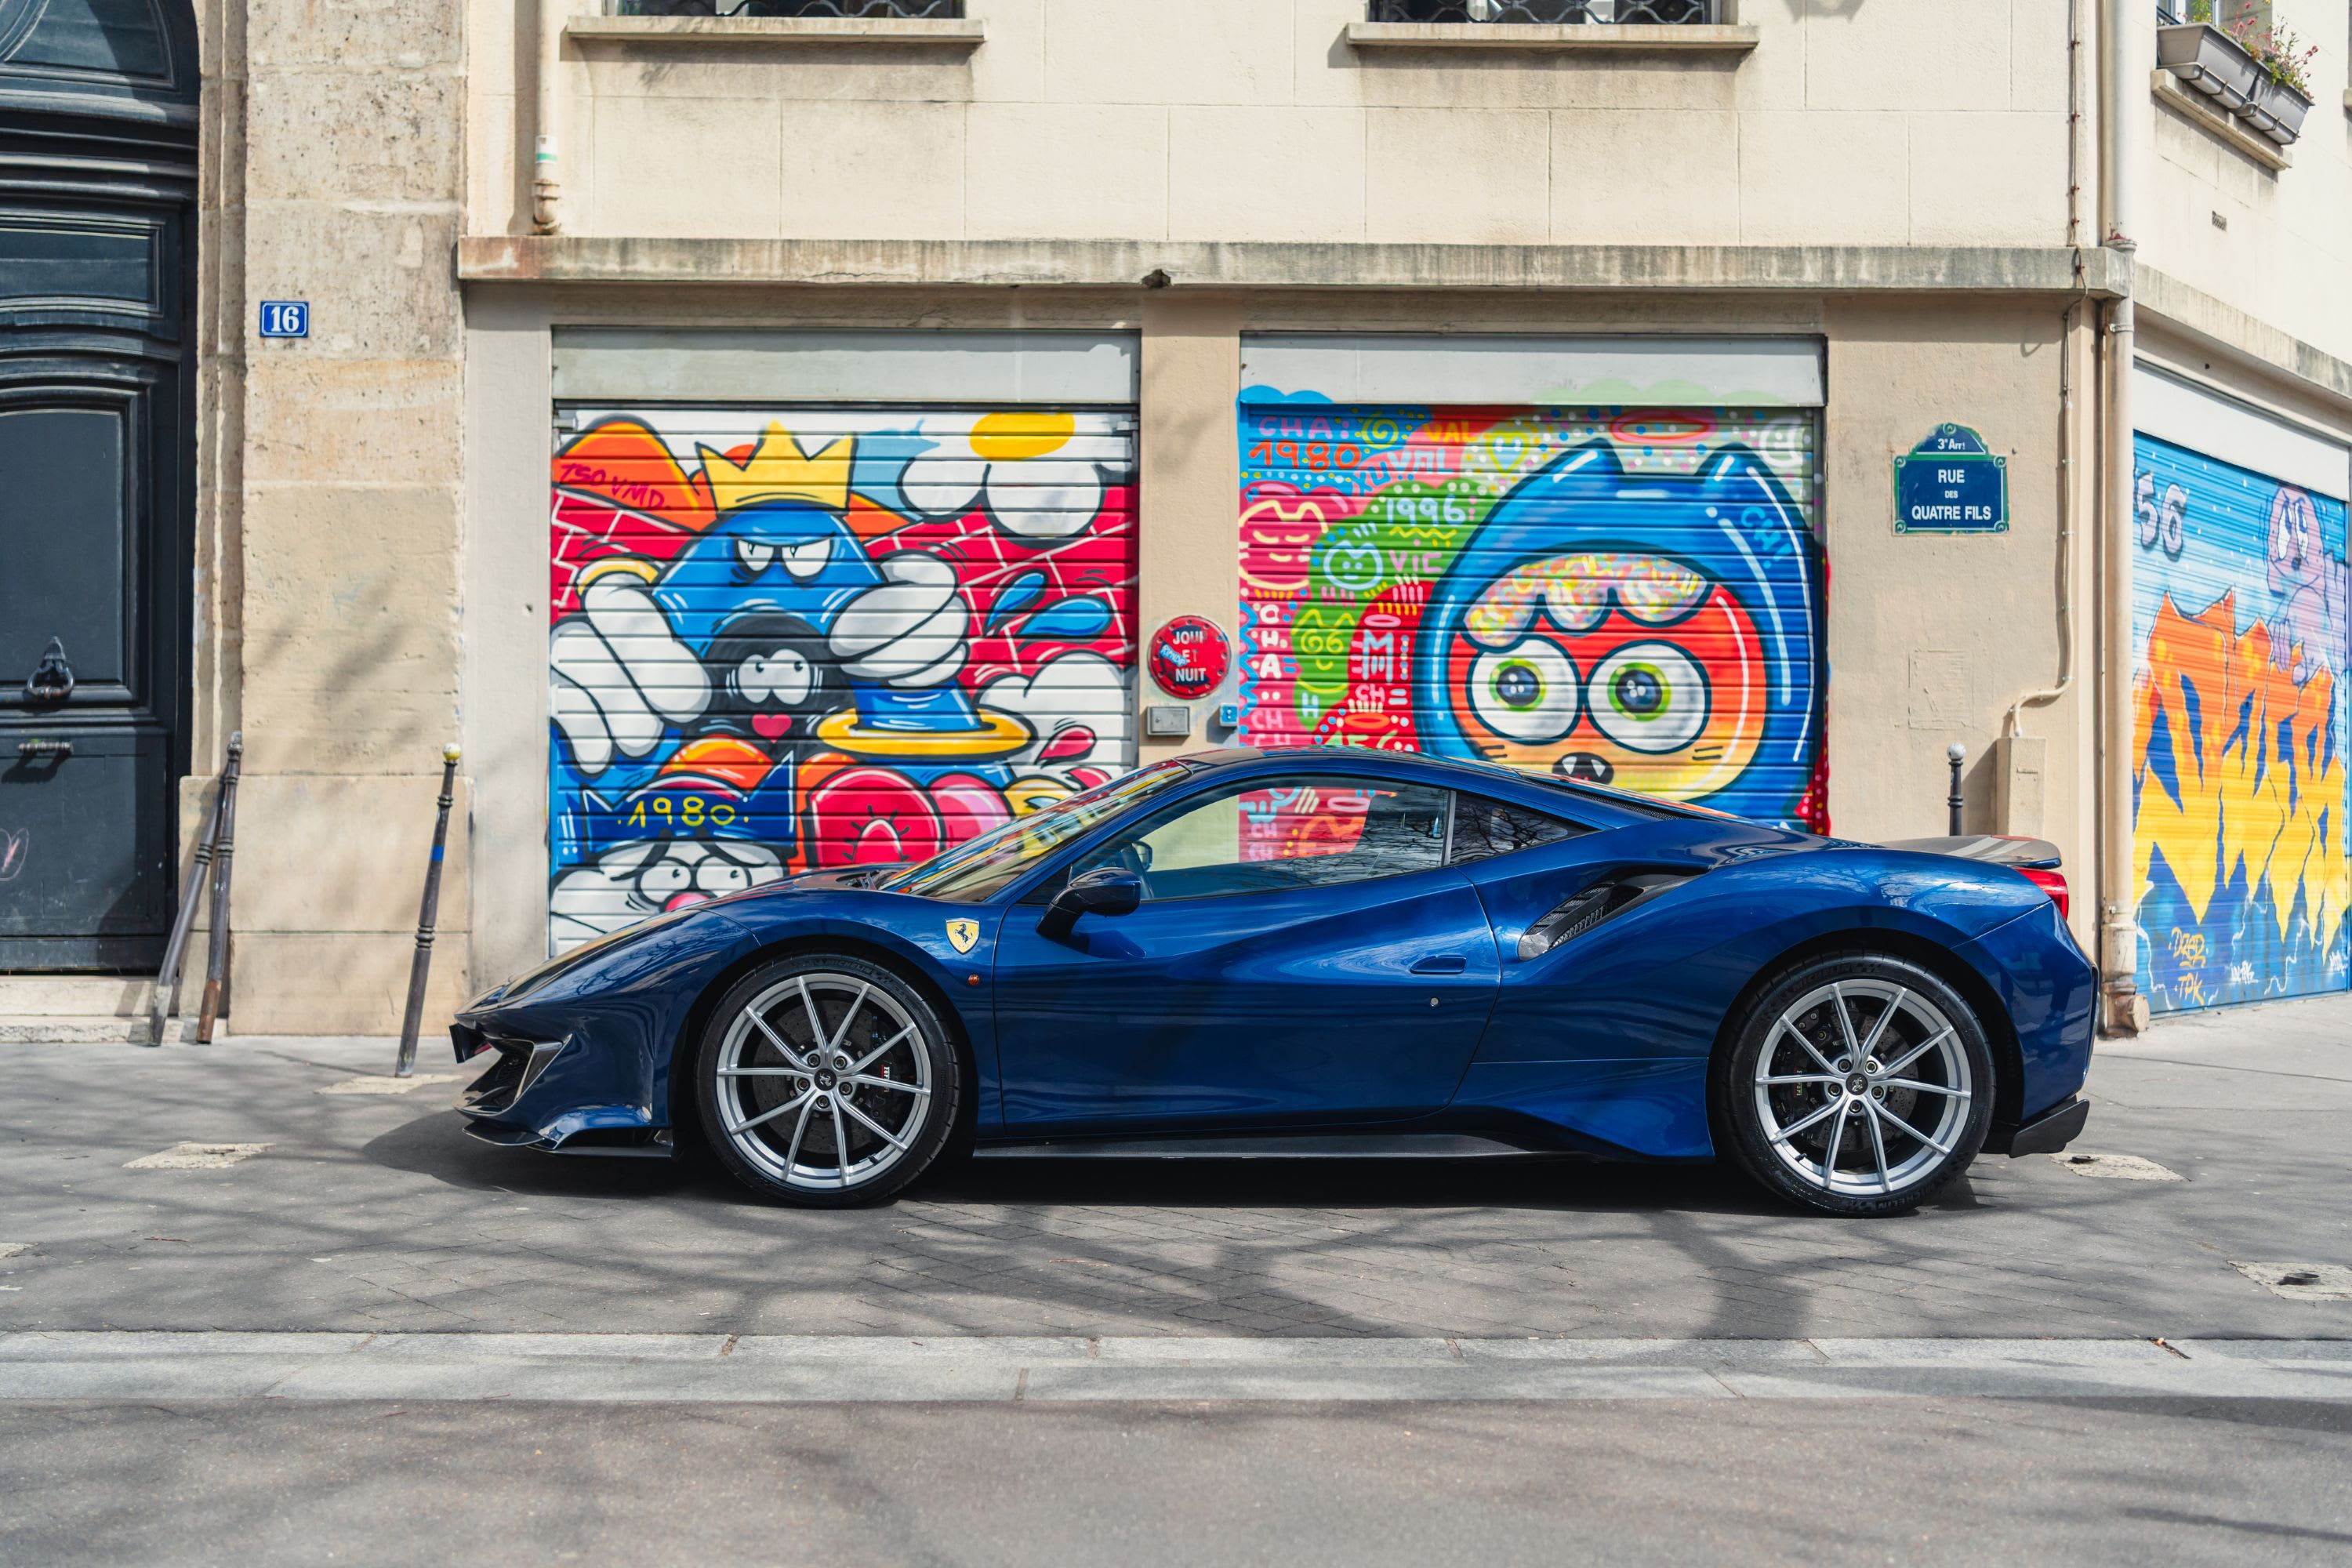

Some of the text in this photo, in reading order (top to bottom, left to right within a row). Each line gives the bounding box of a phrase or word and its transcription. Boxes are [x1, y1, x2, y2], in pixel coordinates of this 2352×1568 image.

[270, 306, 299, 332] 16
[1423, 421, 1479, 443] VAL
[1248, 439, 1362, 473] 1980
[1938, 469, 1965, 483] RUE
[1944, 490, 1958, 499] DES
[1386, 495, 1466, 527] 1996
[1911, 505, 1991, 521] QUATRE FILS
[2136, 471, 2188, 557] 56
[1388, 549, 1443, 574] VIC
[1182, 649, 1199, 663] ET
[1175, 667, 1207, 682] NUIT
[1355, 684, 1386, 702] CH
[1301, 692, 1319, 718] H
[1251, 709, 1283, 729] CH
